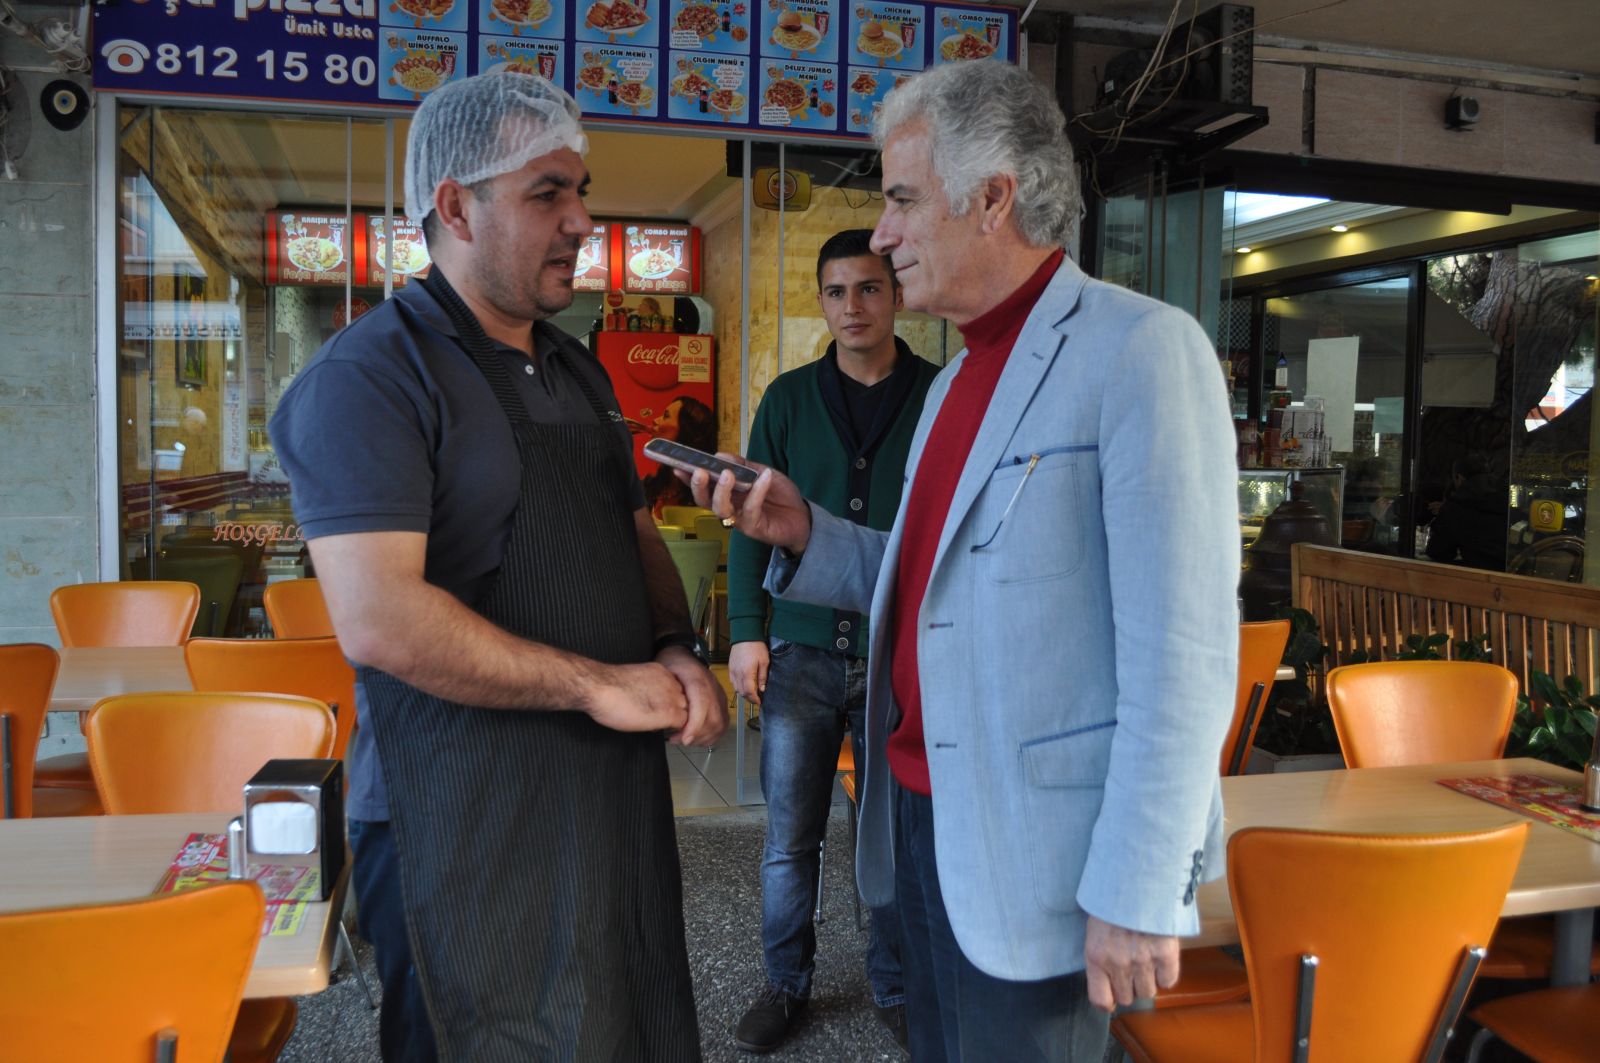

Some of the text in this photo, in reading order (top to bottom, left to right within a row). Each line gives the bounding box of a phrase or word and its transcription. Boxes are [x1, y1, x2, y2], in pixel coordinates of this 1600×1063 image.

[958, 14, 1004, 24] COMBO MENÜ
[284, 14, 374, 39] Ümit Usta
[416, 34, 450, 43] BUFFALO
[537, 43, 560, 51] MENÜ
[625, 50, 647, 58] MENÜ
[155, 43, 377, 86] 812 15 80
[717, 58, 738, 66] MENÜ
[784, 64, 832, 74] DELUX JUMBO
[798, 73, 818, 81] MENÜ
[644, 228, 688, 236] COMBO MENÜ
[573, 275, 606, 289] pizza
[627, 277, 687, 291] foça pizza
